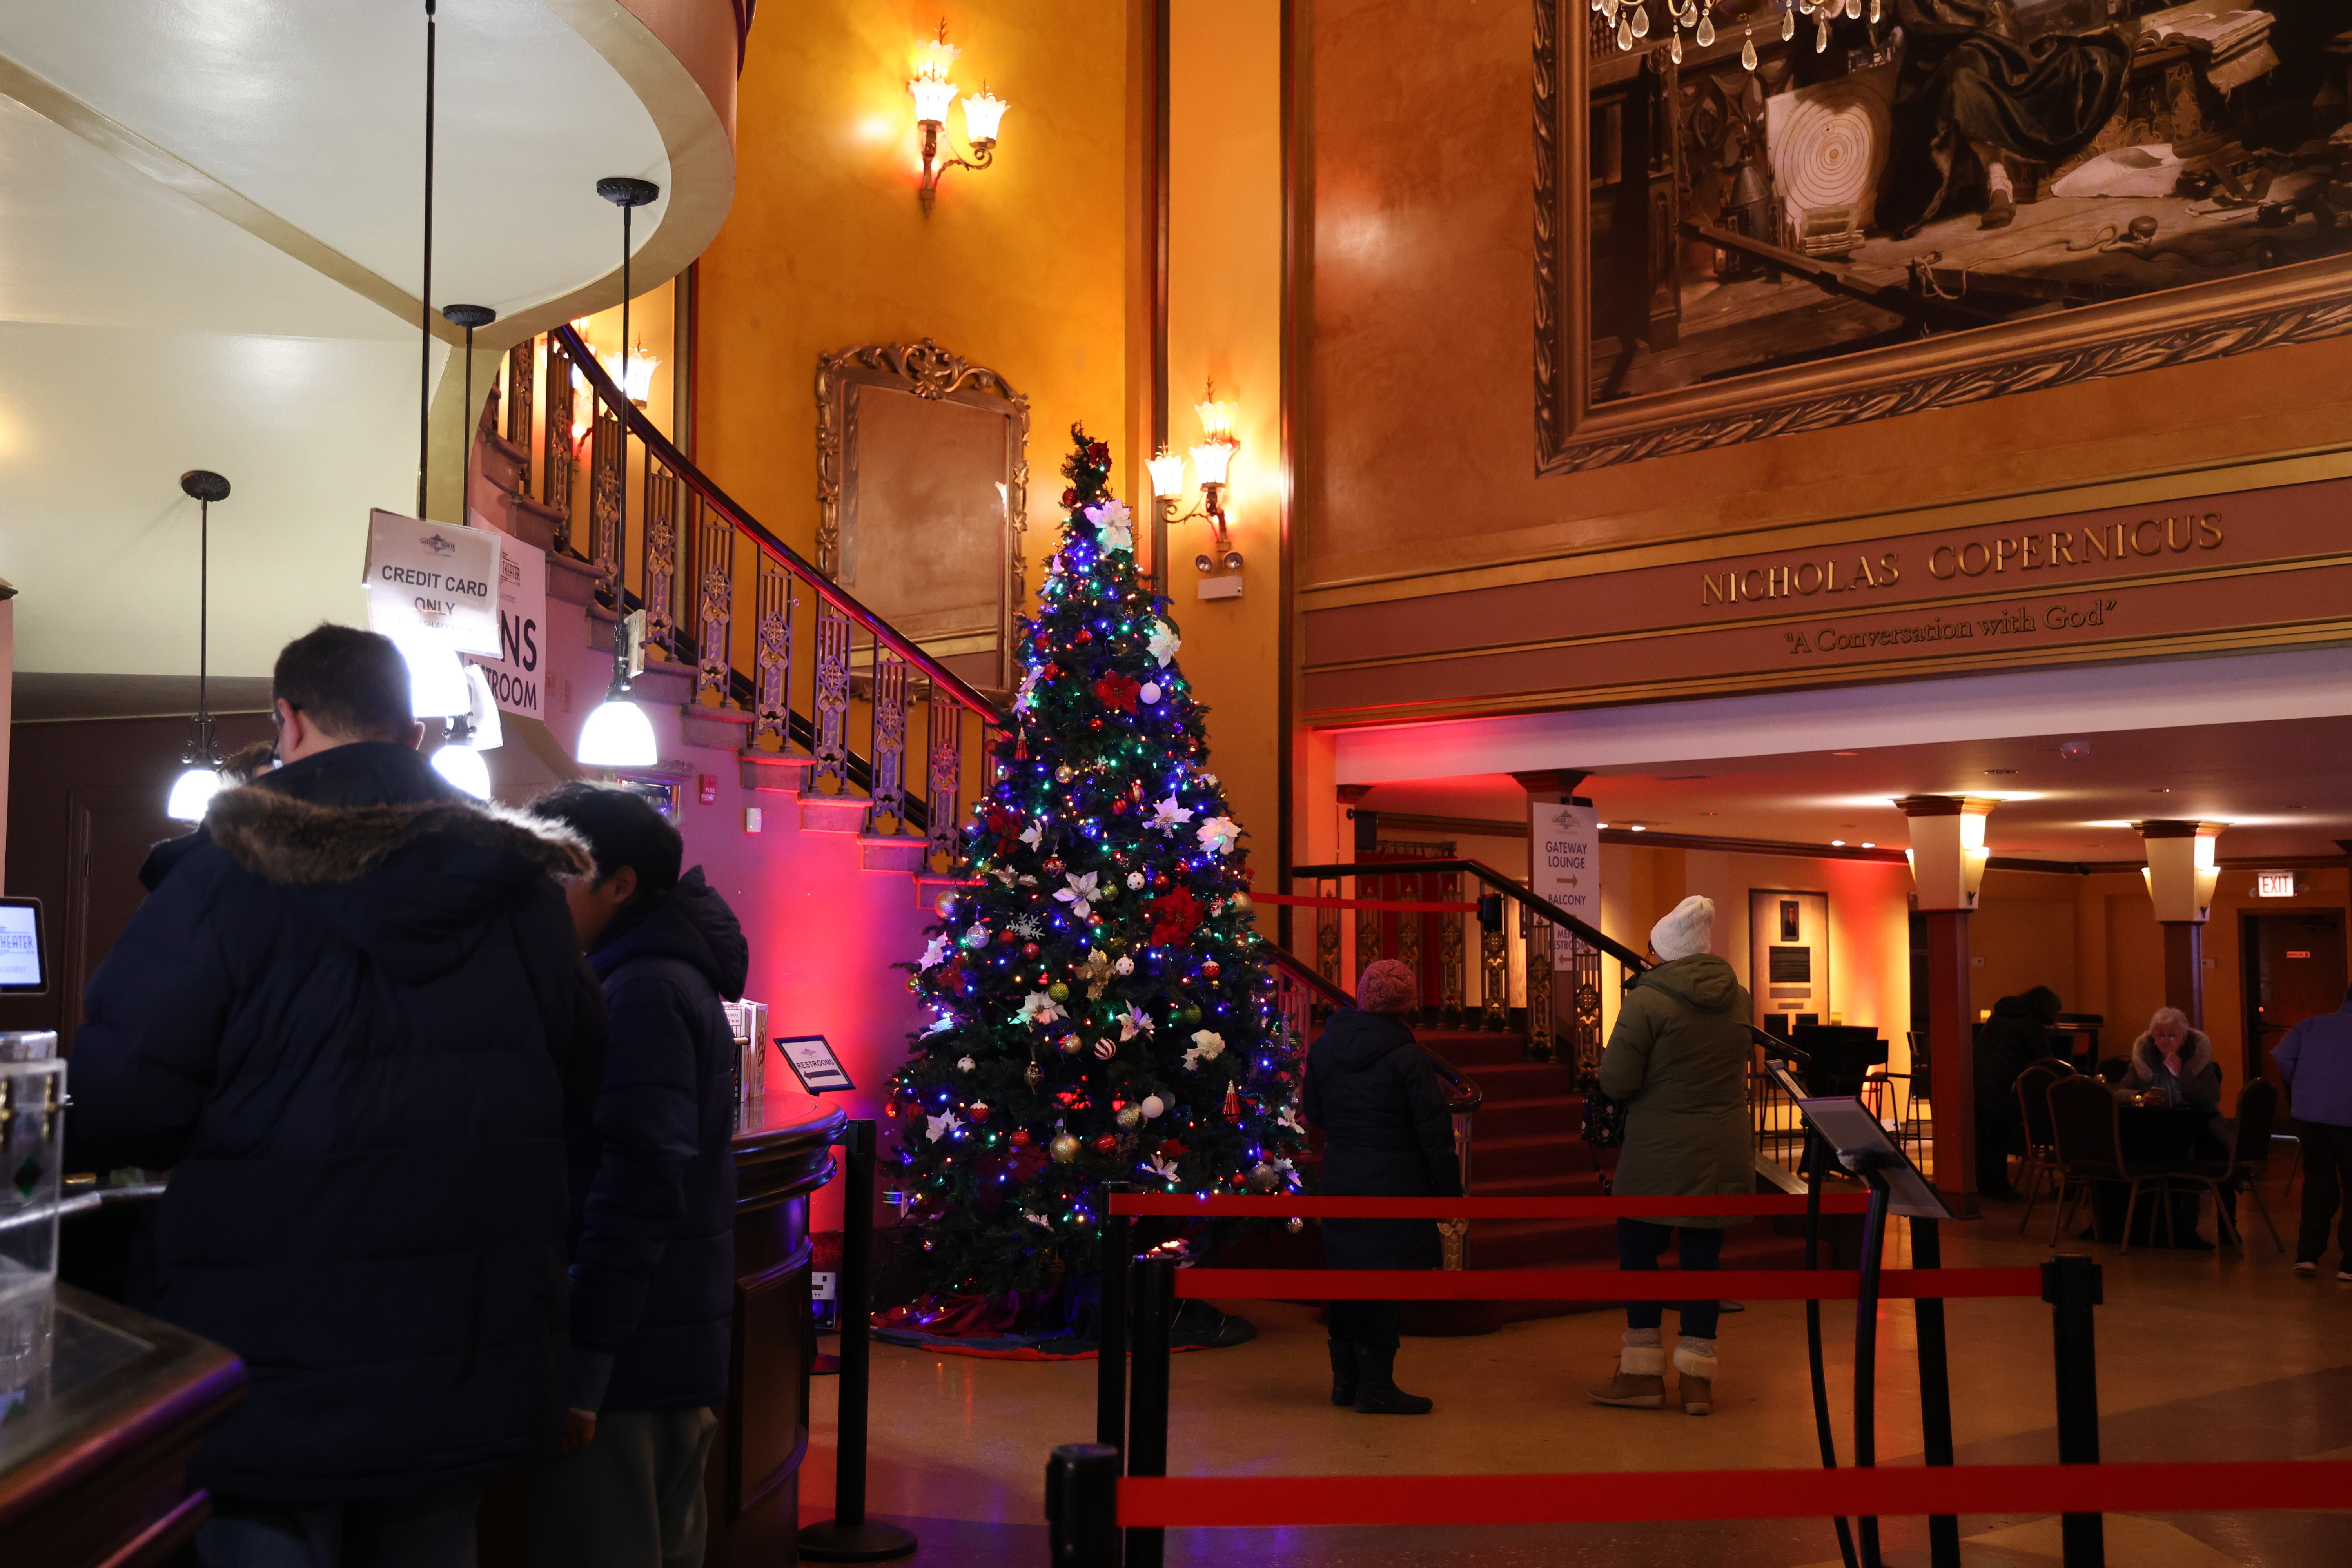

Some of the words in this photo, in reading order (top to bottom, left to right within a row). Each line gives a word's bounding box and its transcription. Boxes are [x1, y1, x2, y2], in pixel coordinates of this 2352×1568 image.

[1702, 553, 1900, 605] NICHOLAS
[1929, 512, 2223, 580] COPERNICUS
[382, 565, 441, 588] CREDIT
[445, 577, 487, 597] CARD
[414, 597, 455, 616] ONLY
[1814, 617, 1973, 651] Conversation
[1978, 607, 2036, 637] with
[500, 610, 537, 672] NS
[1546, 841, 1587, 854] GATEWAY
[1549, 856, 1585, 869] LOUNGE
[2262, 876, 2288, 893] EXIT
[1548, 894, 1586, 905] BALCONY
[0, 936, 34, 949] HEATER
[796, 1059, 834, 1069] RESTROOMS
